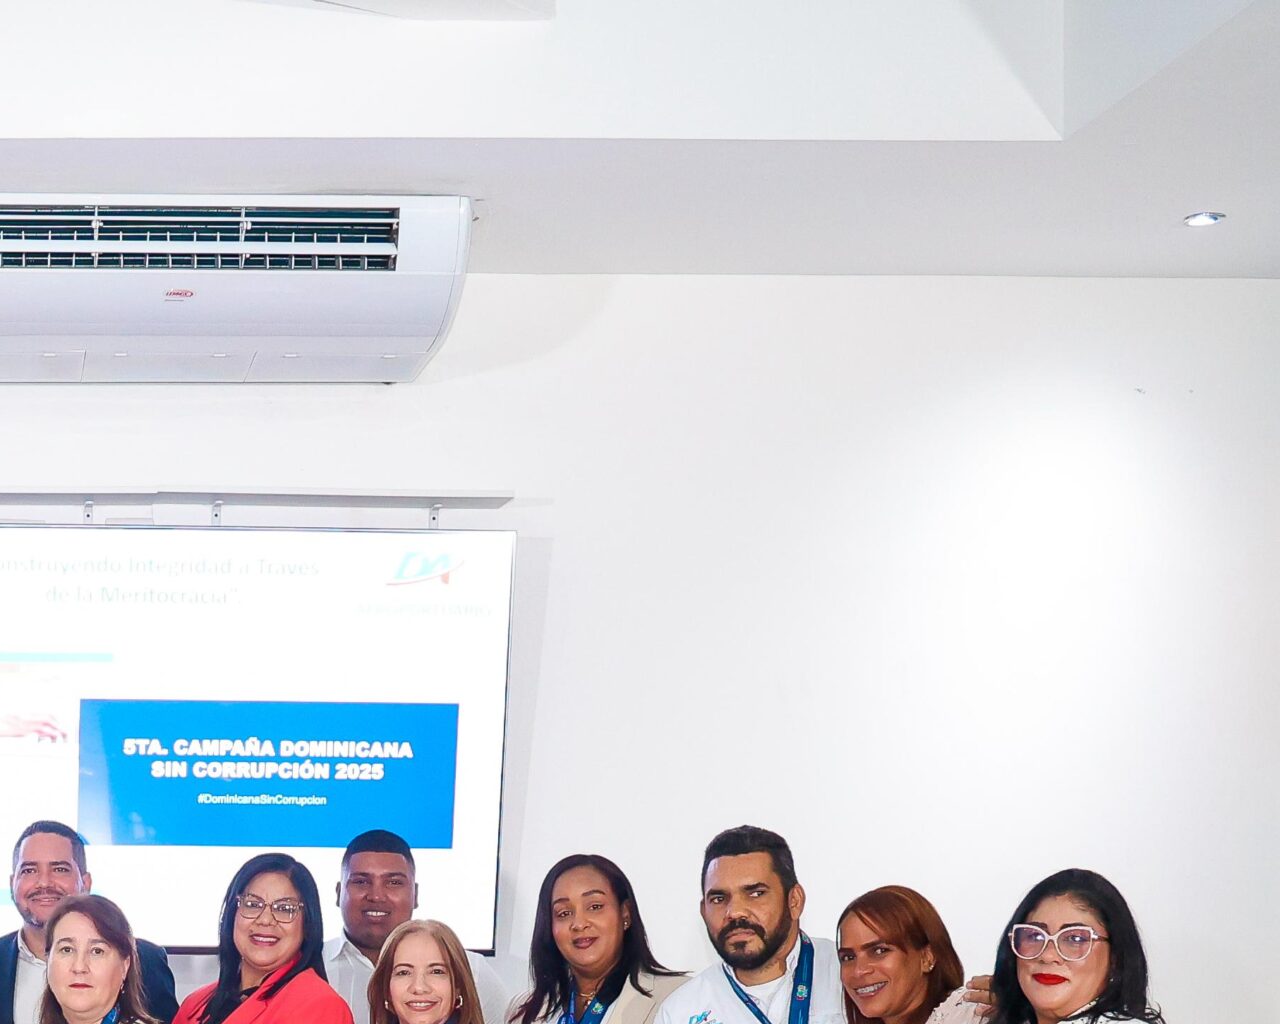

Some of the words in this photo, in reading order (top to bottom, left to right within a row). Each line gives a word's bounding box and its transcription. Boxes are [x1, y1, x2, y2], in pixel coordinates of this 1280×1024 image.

[45, 585, 70, 602] de
[77, 585, 92, 602] la
[122, 738, 168, 755] 5TA.
[173, 737, 275, 756] CAMPAÑA
[280, 740, 414, 758] DOMINICANA
[151, 760, 187, 778] SIN
[192, 759, 330, 779] CORRUPCIÓN
[334, 763, 385, 780] 2025
